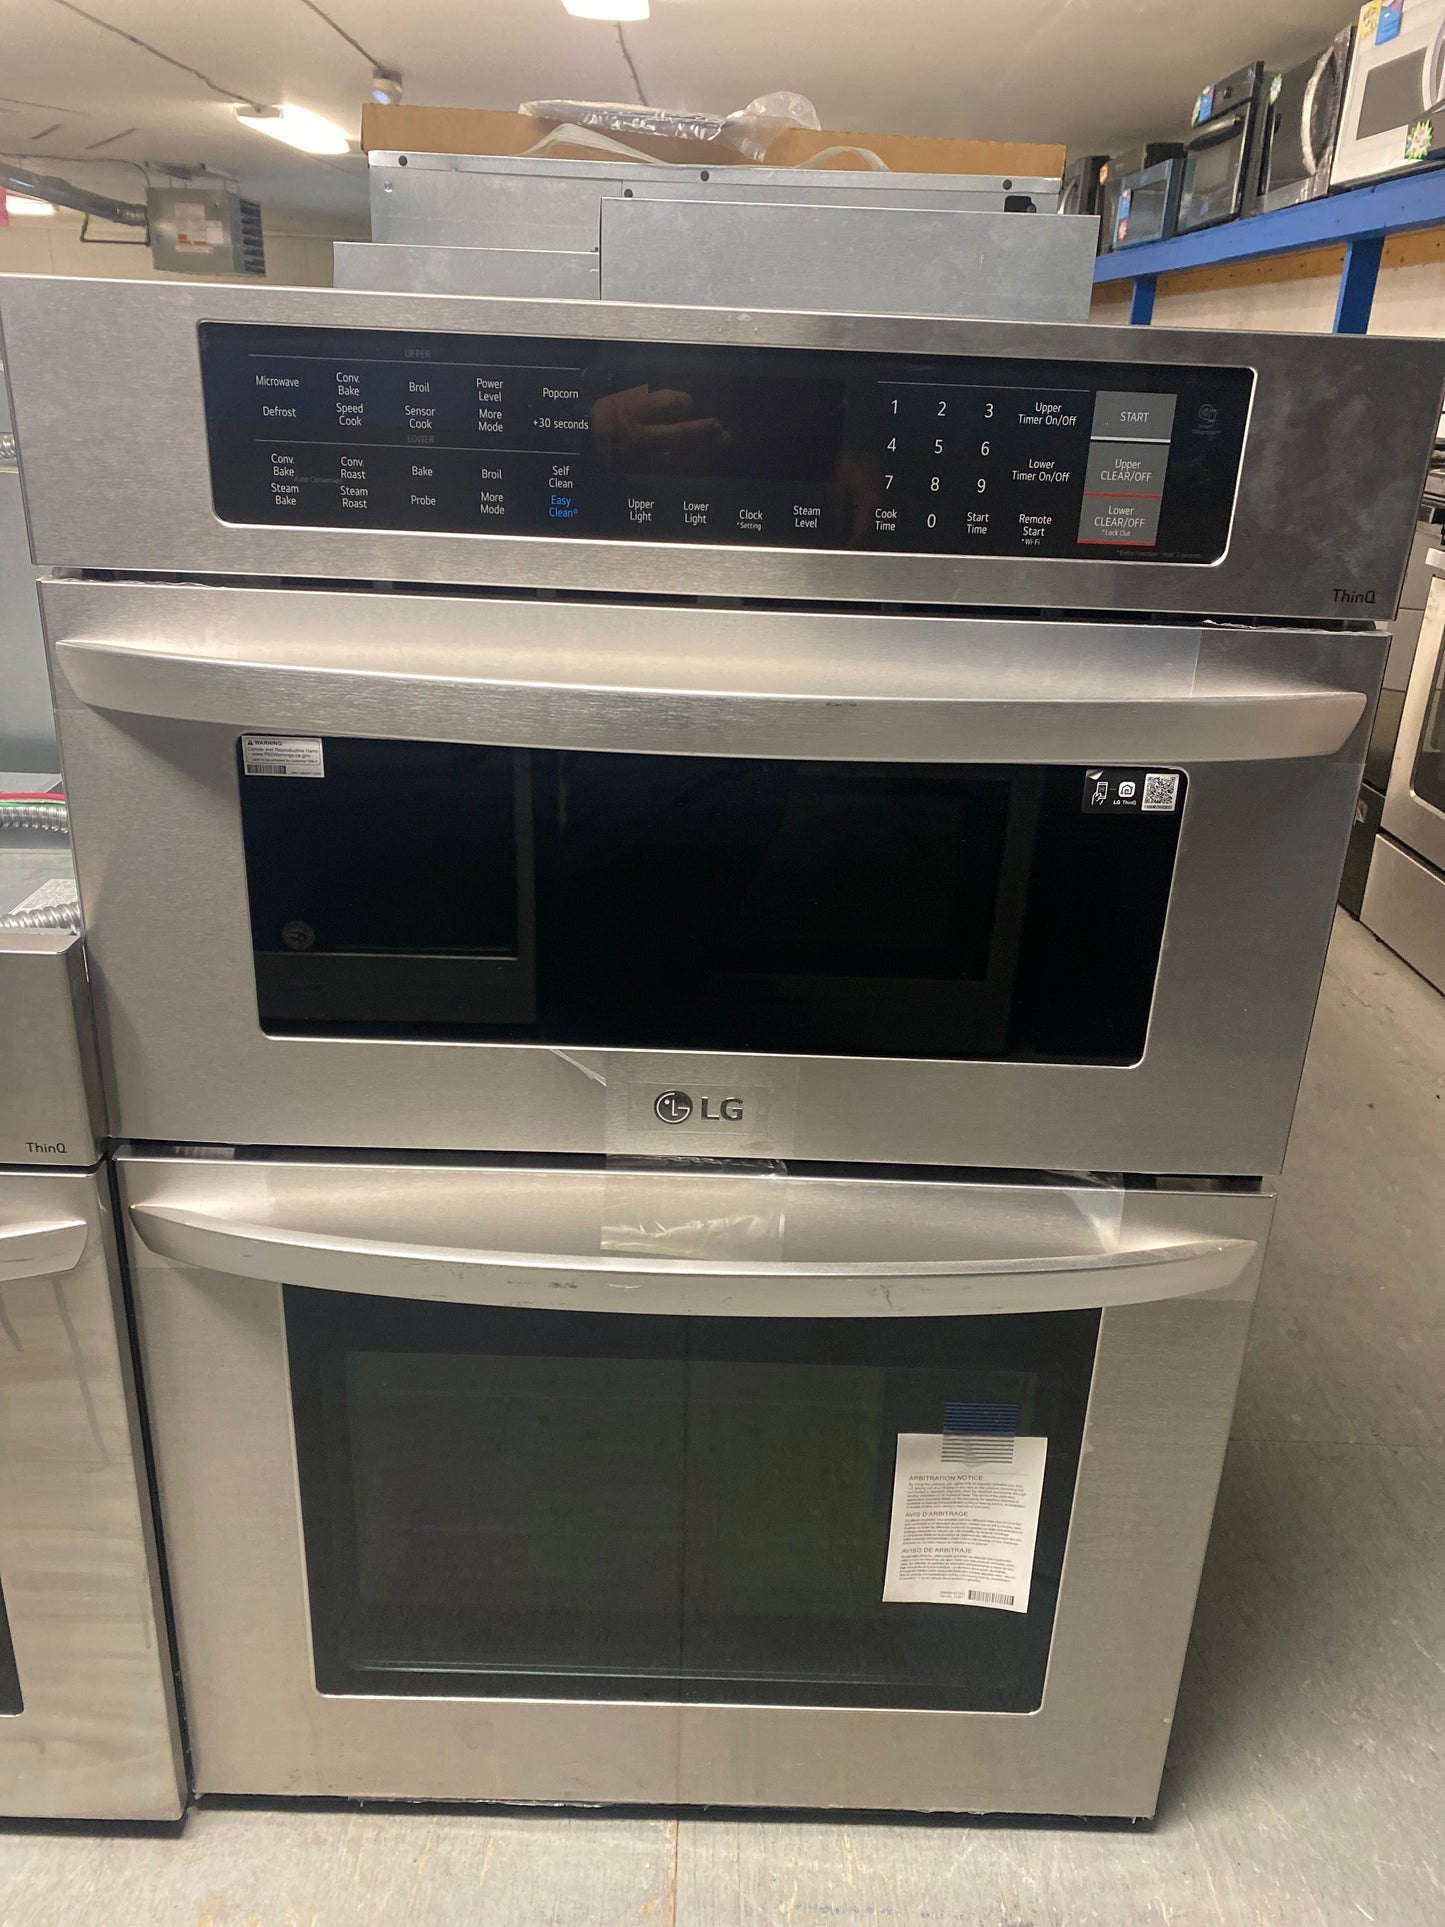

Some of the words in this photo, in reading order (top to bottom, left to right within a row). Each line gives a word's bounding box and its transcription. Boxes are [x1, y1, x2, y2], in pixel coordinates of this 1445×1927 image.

[256, 376, 299, 387] Microwave
[336, 372, 359, 382] Conv.
[409, 382, 429, 392] Broil
[477, 378, 503, 389] Power
[338, 385, 359, 395] Bake
[543, 388, 578, 400] Popcorn
[479, 391, 501, 401] Level
[263, 406, 296, 417] Defrost
[336, 403, 363, 416] Speed
[405, 405, 435, 416] Sensor
[892, 400, 897, 414] 1
[938, 402, 946, 416] 2
[985, 403, 993, 418] 3
[1036, 402, 1062, 414] Upper
[480, 409, 502, 419] More
[1121, 412, 1149, 422] START
[339, 415, 361, 425] Cook
[410, 418, 432, 429] Cook
[533, 418, 551, 429] +30
[554, 420, 588, 429] seconds
[1019, 413, 1043, 424] Timer
[1046, 415, 1077, 426] On/Off
[479, 421, 503, 431] Mode
[887, 438, 896, 451] 4
[935, 440, 942, 454] 5
[982, 442, 989, 455] 6
[271, 454, 294, 464] Conv.
[341, 457, 364, 466] Conv.
[1029, 459, 1055, 469] Lower
[1115, 459, 1141, 471] Upper
[274, 466, 294, 476] Bake
[341, 469, 365, 479] Roast
[412, 466, 432, 476] Bake
[482, 469, 502, 479] Broil
[553, 466, 569, 475] Self
[1013, 471, 1036, 480] Timer
[1039, 472, 1070, 482] On/Off
[1101, 470, 1152, 482] CLEAR/OFF
[549, 478, 573, 488] Clean
[885, 475, 893, 489] 7
[931, 477, 939, 491] 8
[978, 479, 985, 493] 9
[271, 483, 299, 493] Steam
[340, 486, 368, 495] Steam
[276, 495, 296, 505] Bake
[411, 495, 436, 505] Probe
[481, 492, 503, 502] More
[552, 495, 571, 508] Easy
[343, 498, 367, 508] Roast
[629, 498, 654, 510] Upper
[684, 501, 709, 511] Lower
[481, 504, 504, 514] Mode
[794, 505, 820, 515] Steam
[876, 509, 897, 518] Cook
[1109, 506, 1134, 515] Lower
[630, 511, 651, 523] Light
[685, 513, 706, 525] Light
[740, 510, 762, 519] Clock
[967, 512, 989, 522] Start
[1019, 514, 1052, 524] Remote
[795, 518, 817, 527] Level
[875, 521, 895, 530] Time
[1095, 517, 1145, 528] CLEAR/OFF
[967, 524, 987, 534] Time
[1023, 526, 1045, 536] Start
[1333, 589, 1376, 603] ThinQ
[701, 1096, 743, 1120] LG
[26, 1142, 67, 1154] ThinQ
